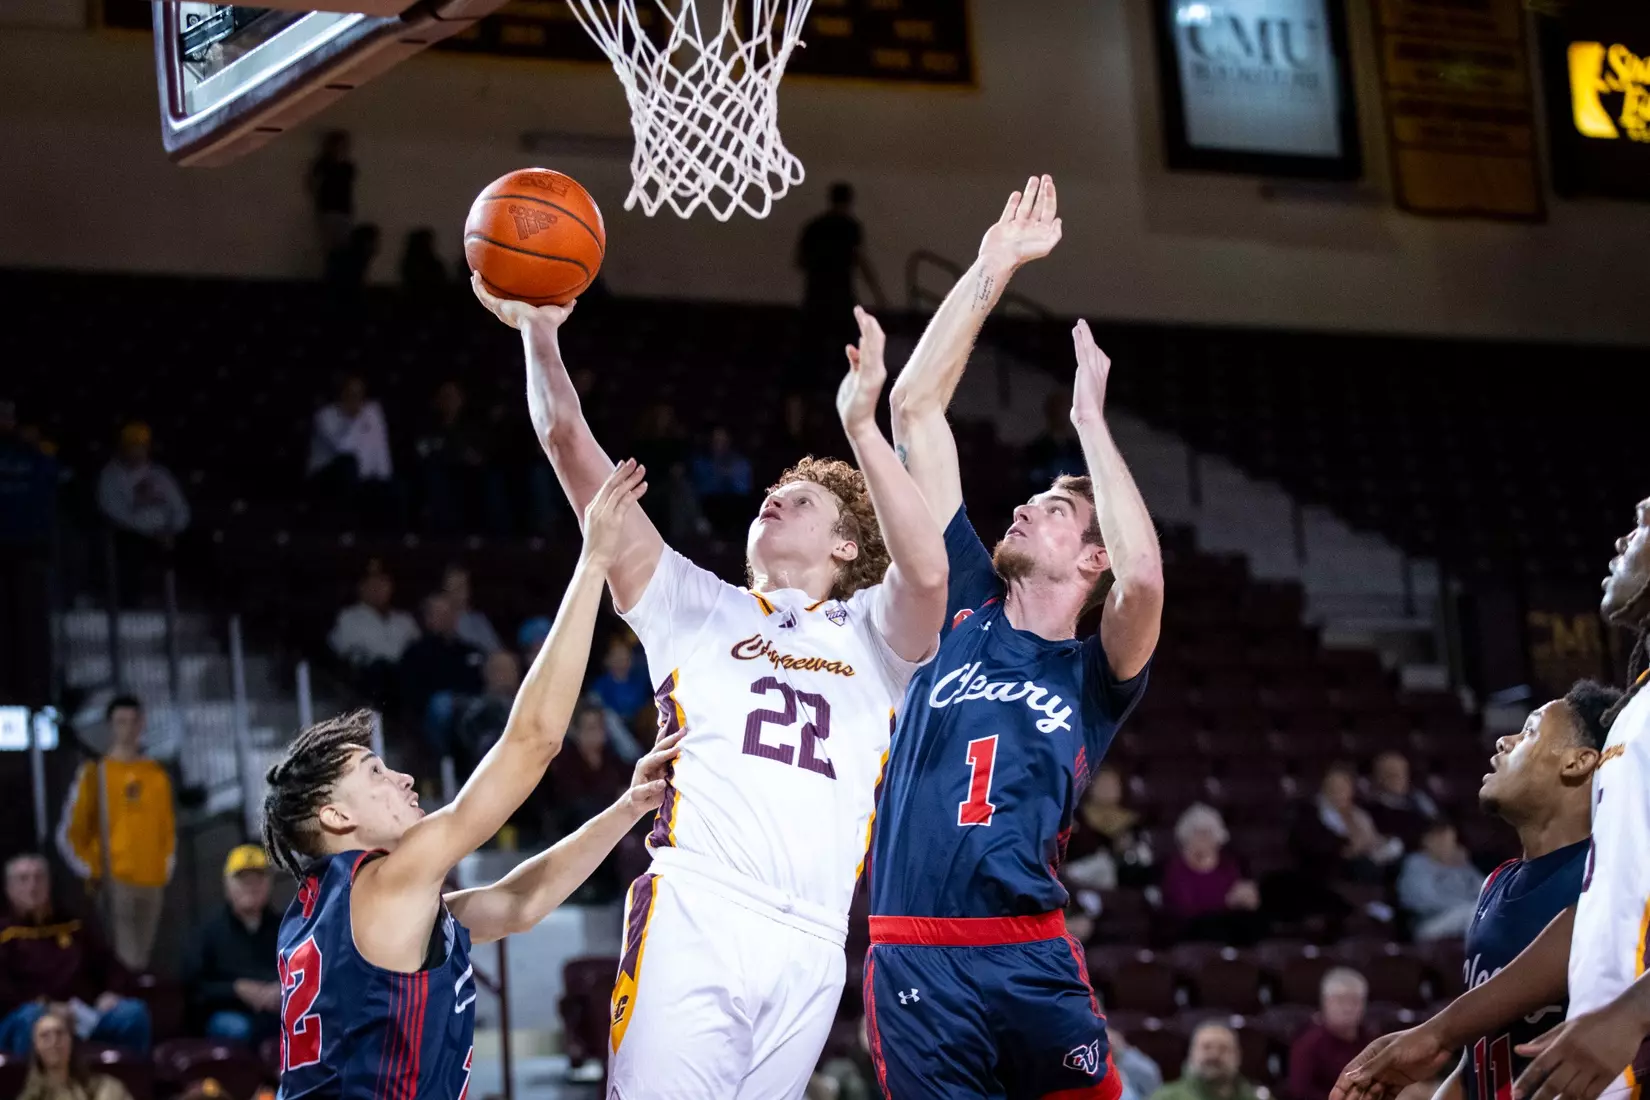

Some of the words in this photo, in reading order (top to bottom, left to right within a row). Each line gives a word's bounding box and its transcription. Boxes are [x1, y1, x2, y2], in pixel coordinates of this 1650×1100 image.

[1184, 15, 1318, 70] CMU
[741, 676, 837, 780] 22
[929, 661, 1073, 733] Cleary
[957, 733, 999, 827] 1
[1473, 1032, 1516, 1100] 11
